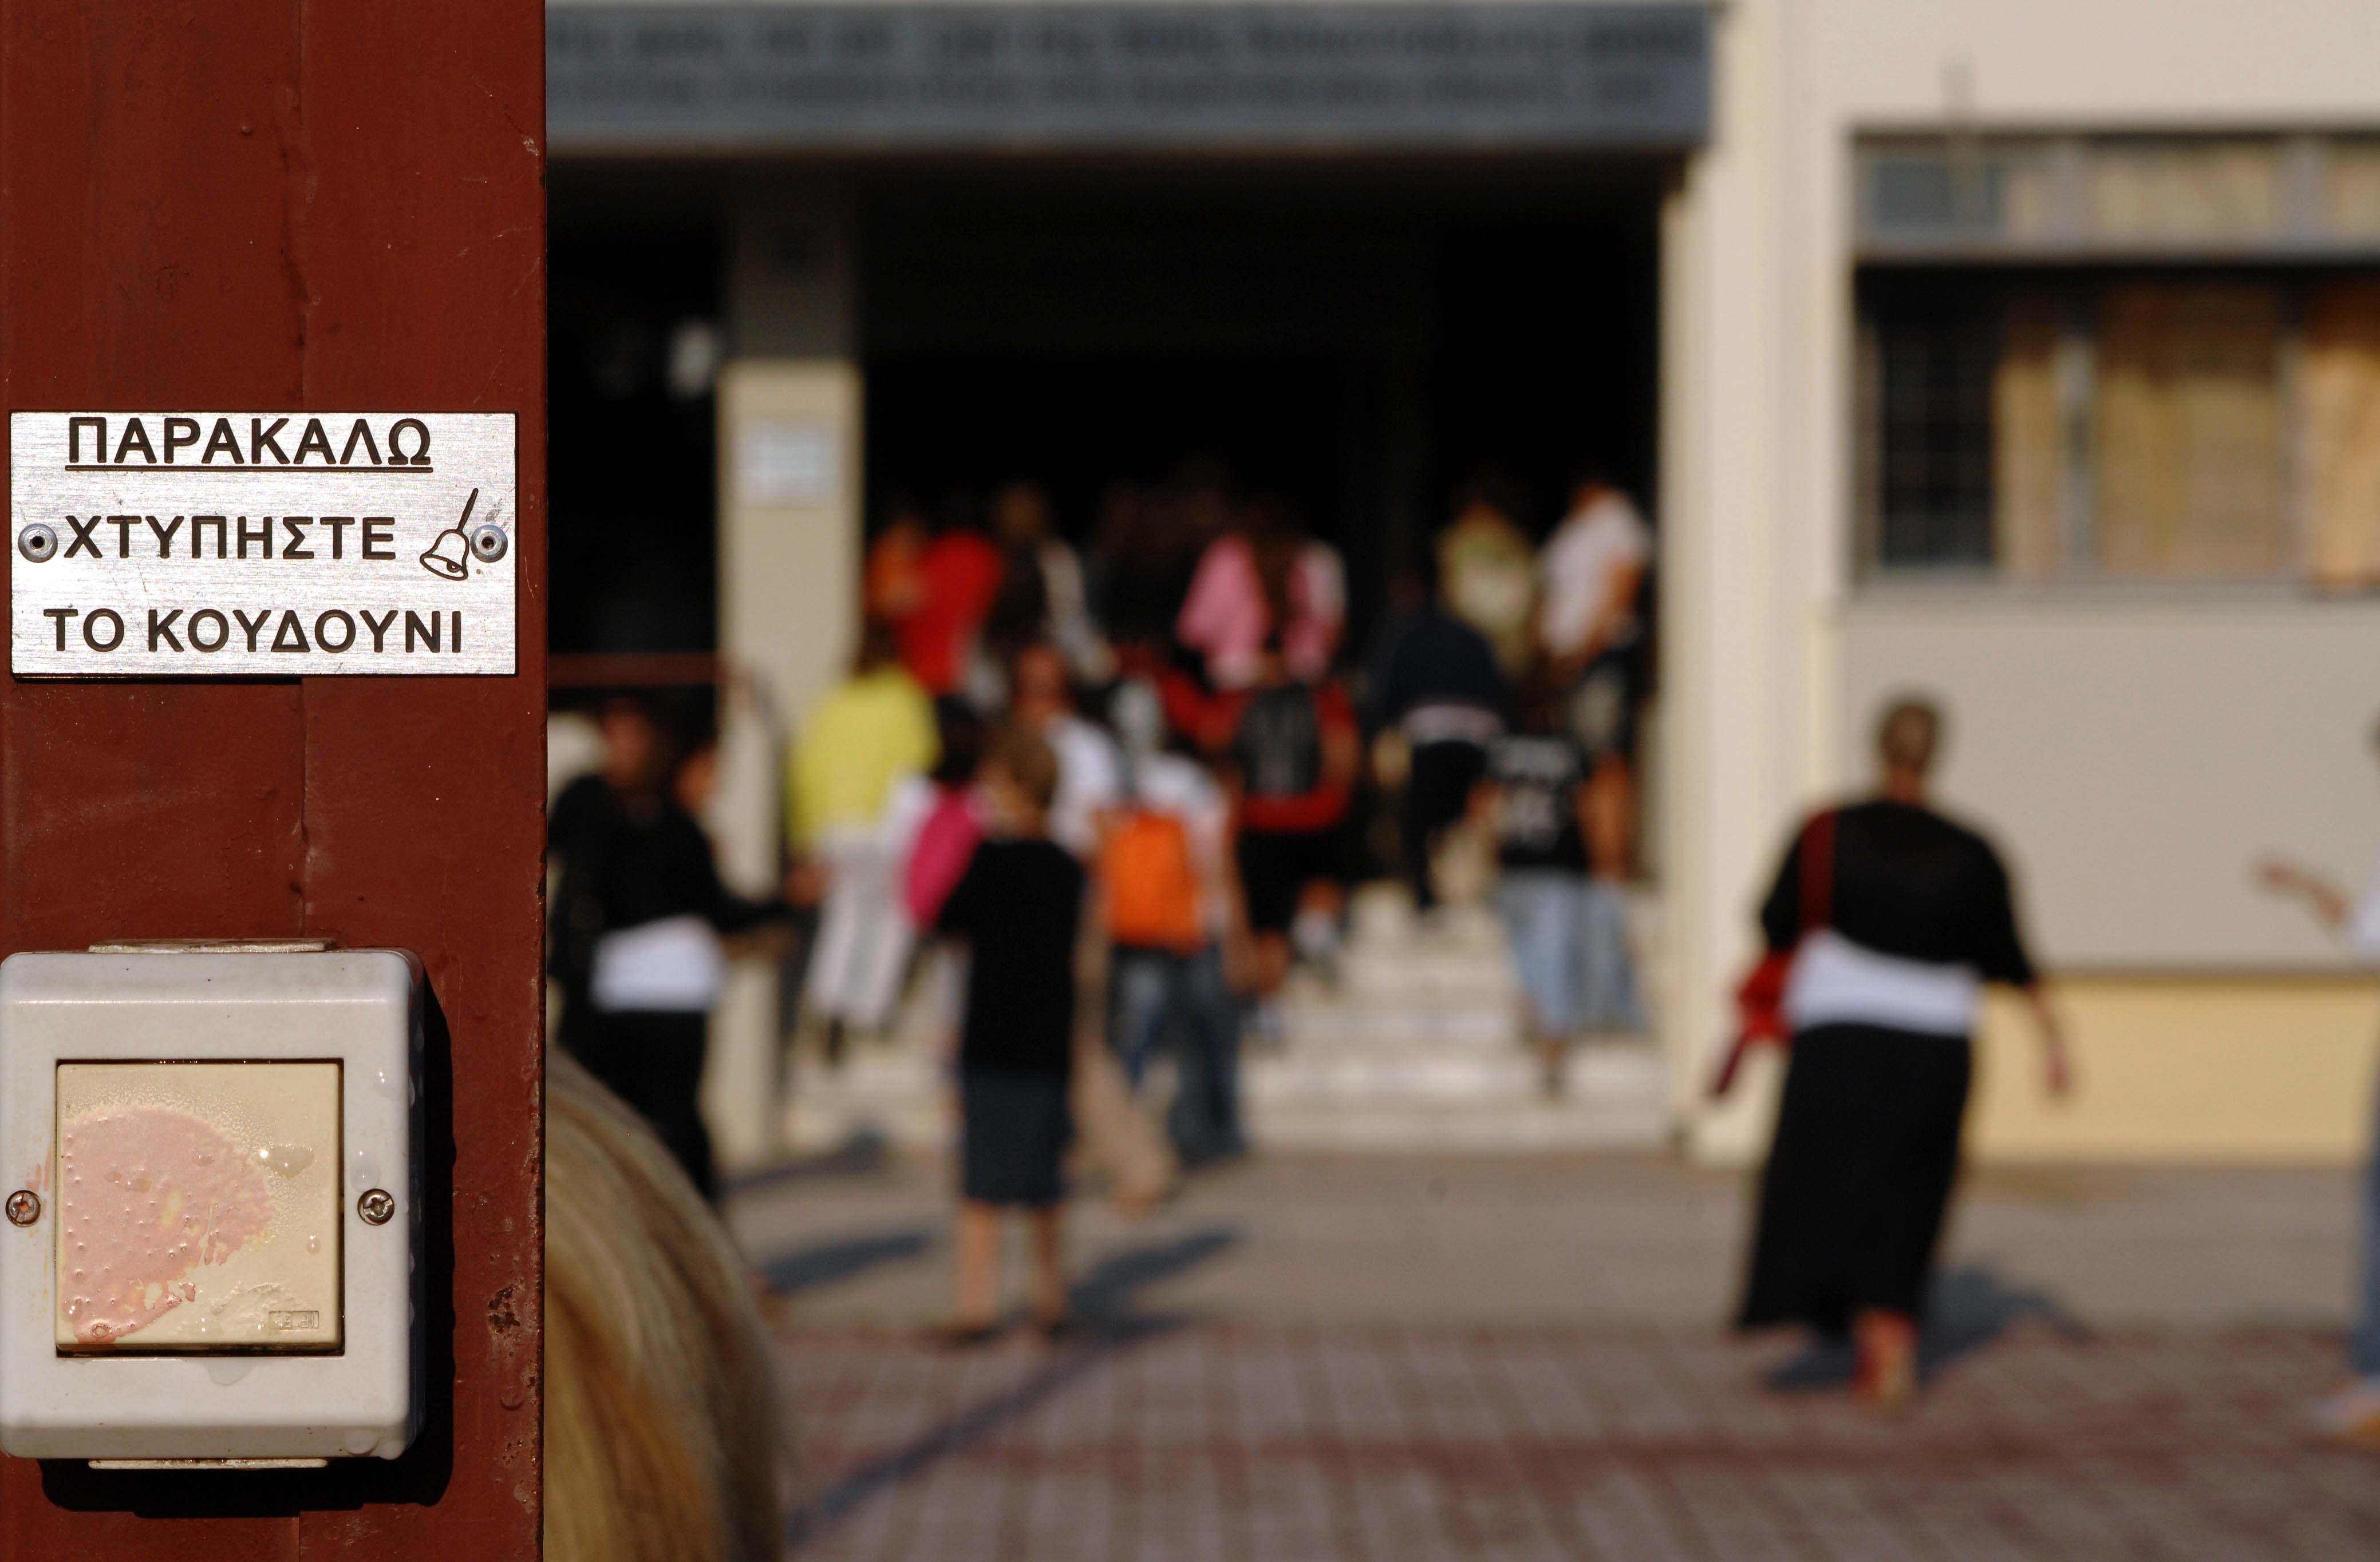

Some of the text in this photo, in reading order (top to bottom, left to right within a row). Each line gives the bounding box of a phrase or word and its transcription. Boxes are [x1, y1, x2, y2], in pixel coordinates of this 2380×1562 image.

[69, 417, 431, 465] ΠΑΡΑΚΑΛΩ
[64, 515, 396, 560] ΧΤΥΠΗΣΤΕ
[43, 608, 461, 653] ΤΟ ΚΟΥΔΟΥΝΙ
